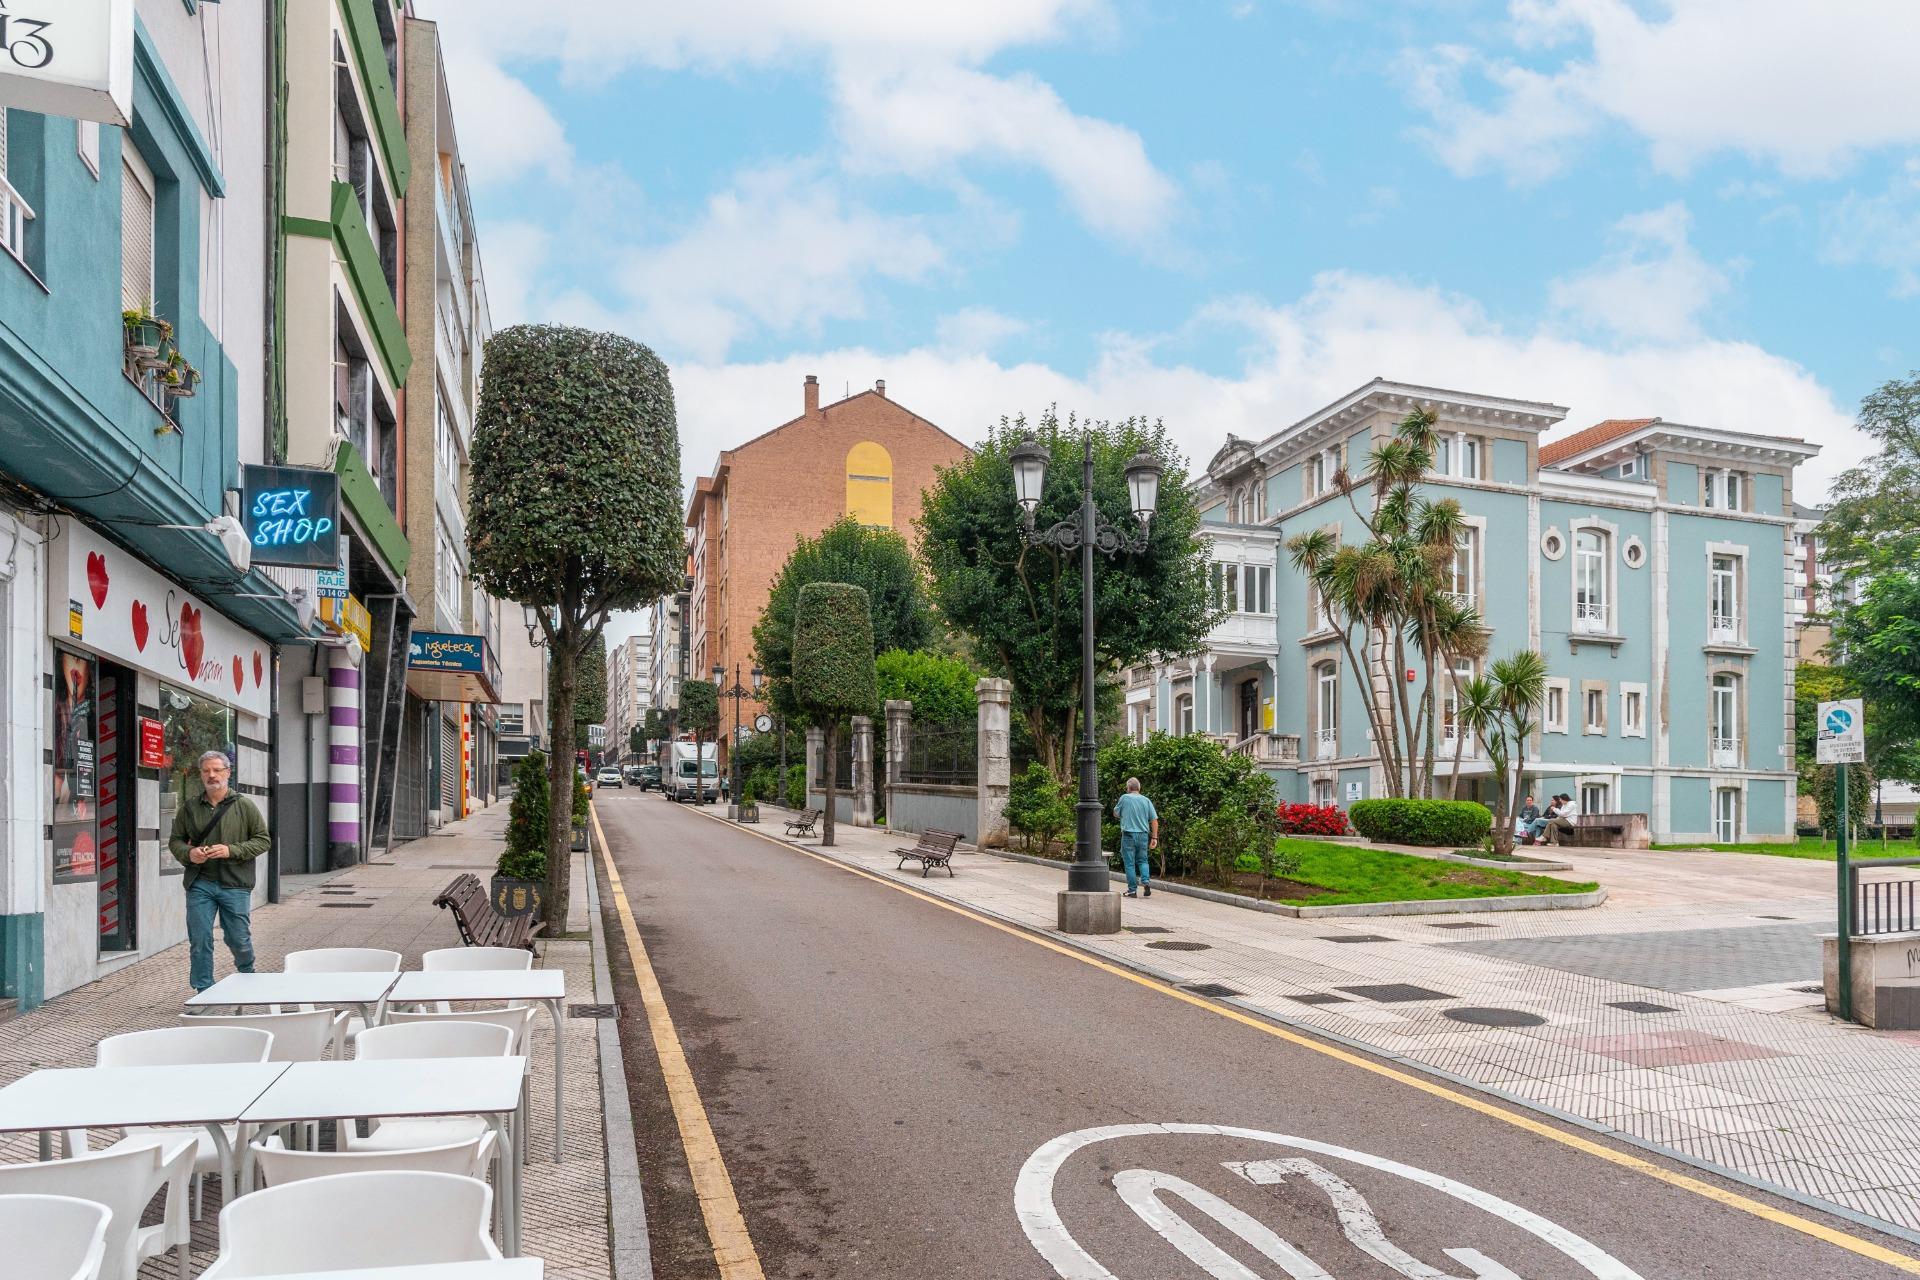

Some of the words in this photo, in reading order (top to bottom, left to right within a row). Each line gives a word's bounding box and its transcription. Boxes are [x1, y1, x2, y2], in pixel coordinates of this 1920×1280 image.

[252, 489, 311, 517] SEX
[254, 517, 332, 546] SHOP
[328, 589, 336, 597] 14
[338, 590, 347, 598] 05
[425, 637, 474, 658] juguetecas
